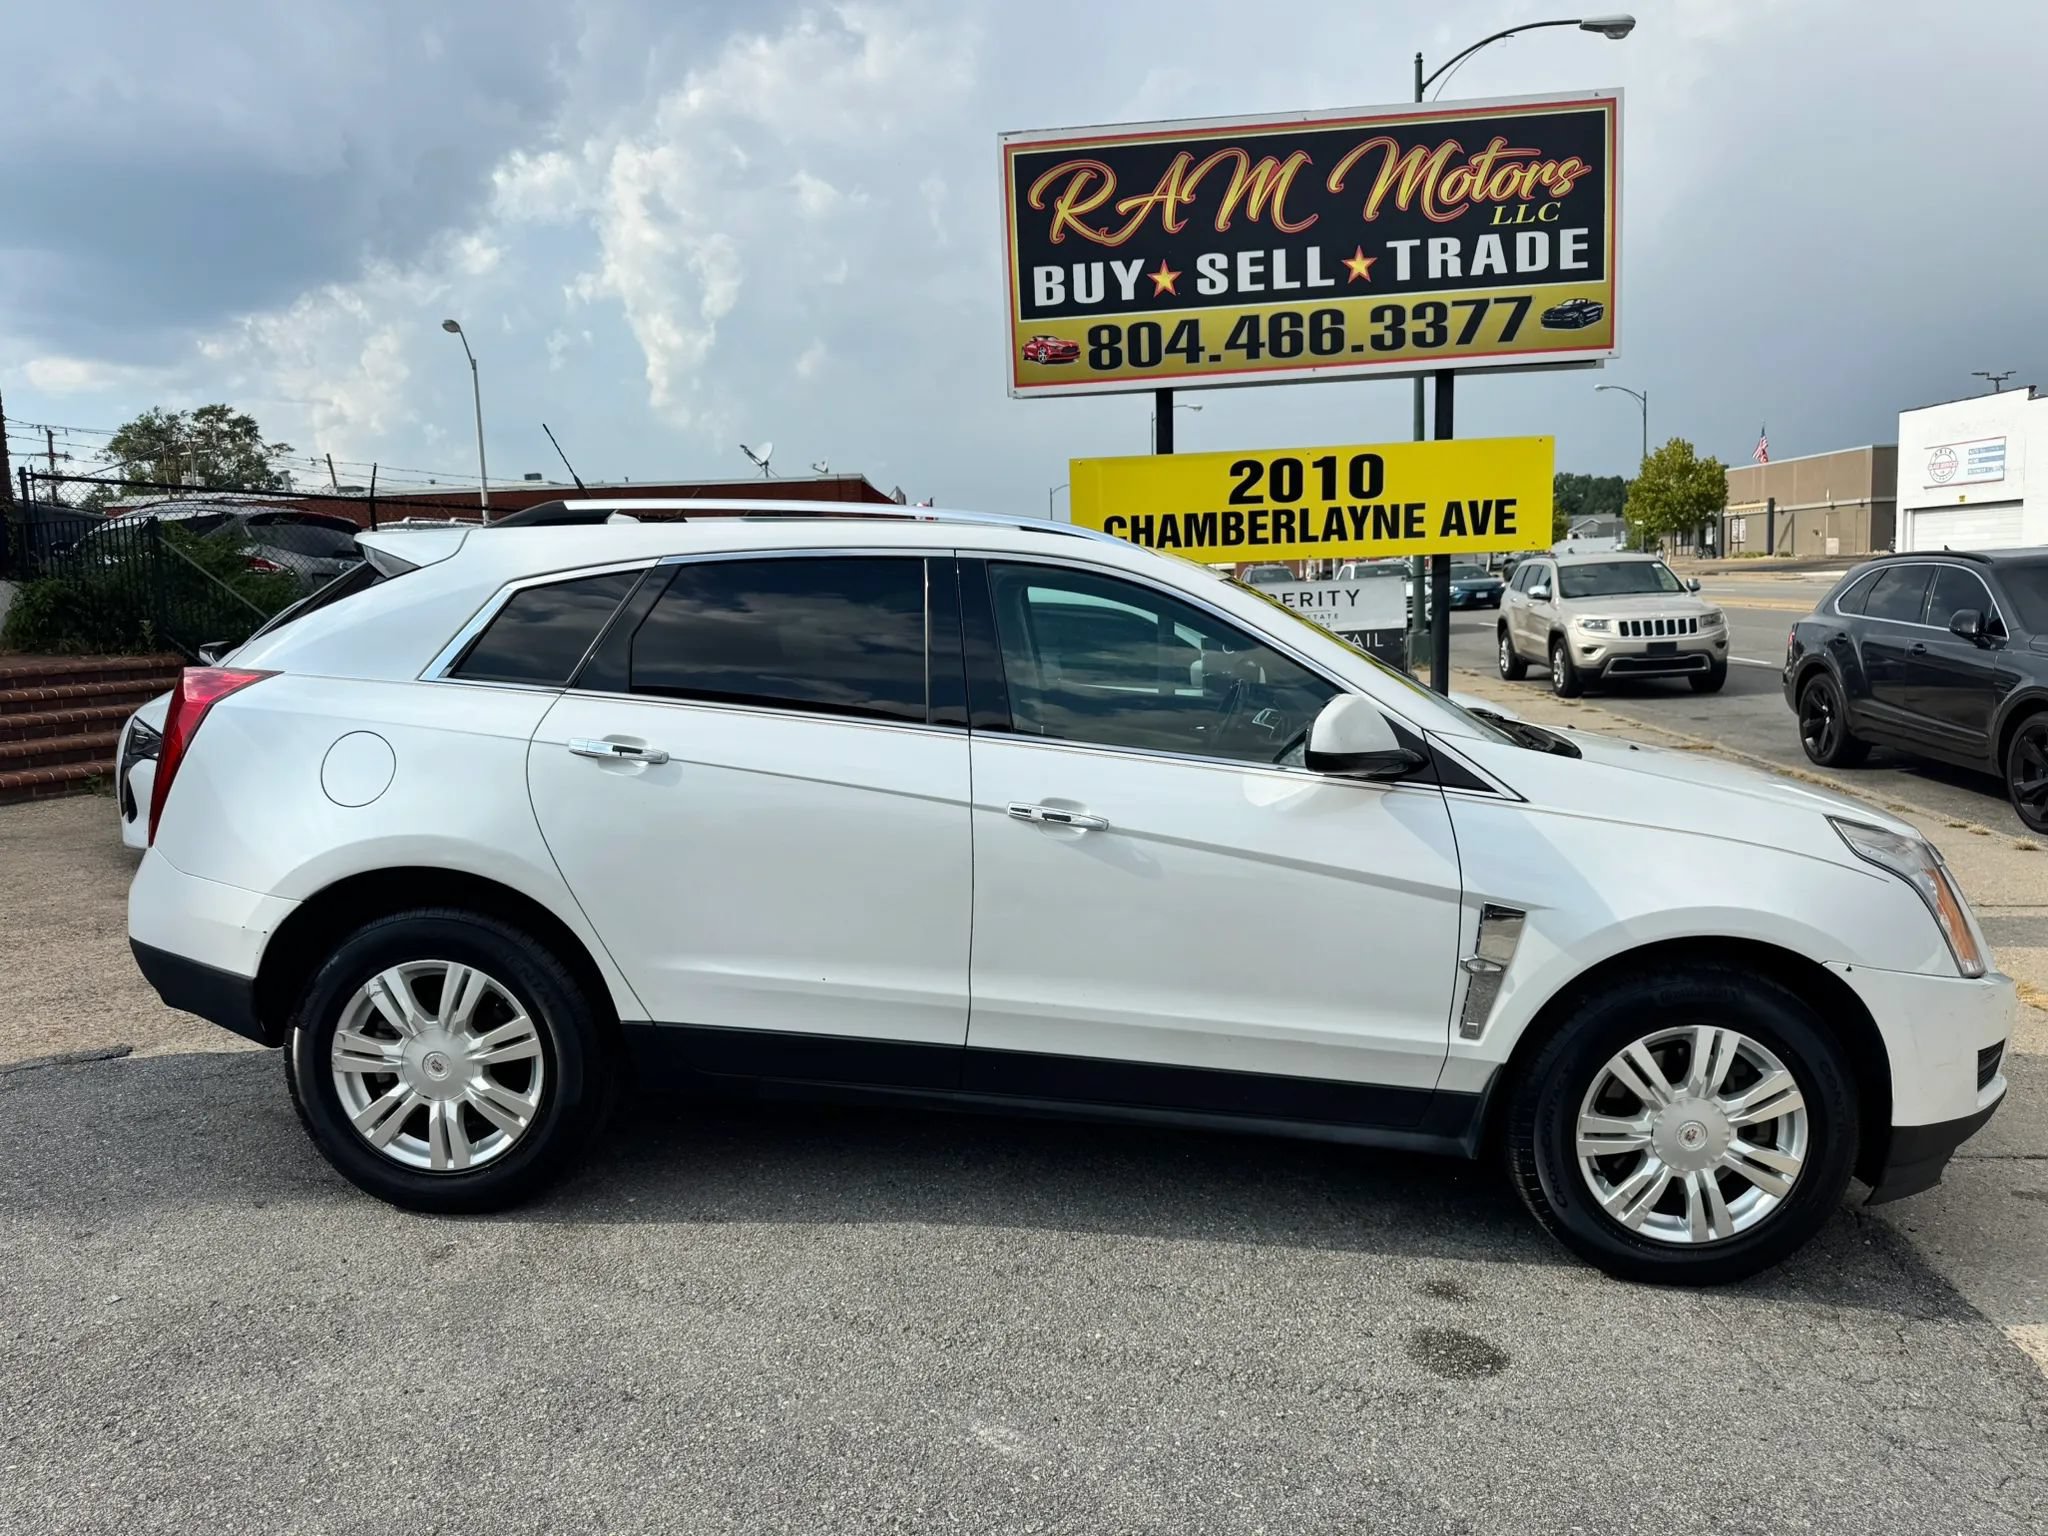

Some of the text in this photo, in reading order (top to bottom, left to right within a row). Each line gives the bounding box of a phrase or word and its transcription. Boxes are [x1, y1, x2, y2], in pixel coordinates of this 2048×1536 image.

[1027, 135, 1592, 246] RAM Motors
[1489, 201, 1562, 227] LLC
[1033, 227, 1590, 307] BUY SELL TRADE
[1087, 296, 1537, 371] 804.466.3377
[1228, 453, 1384, 505] 2010
[1104, 499, 1517, 549] CHAMBERLAYNE AVE
